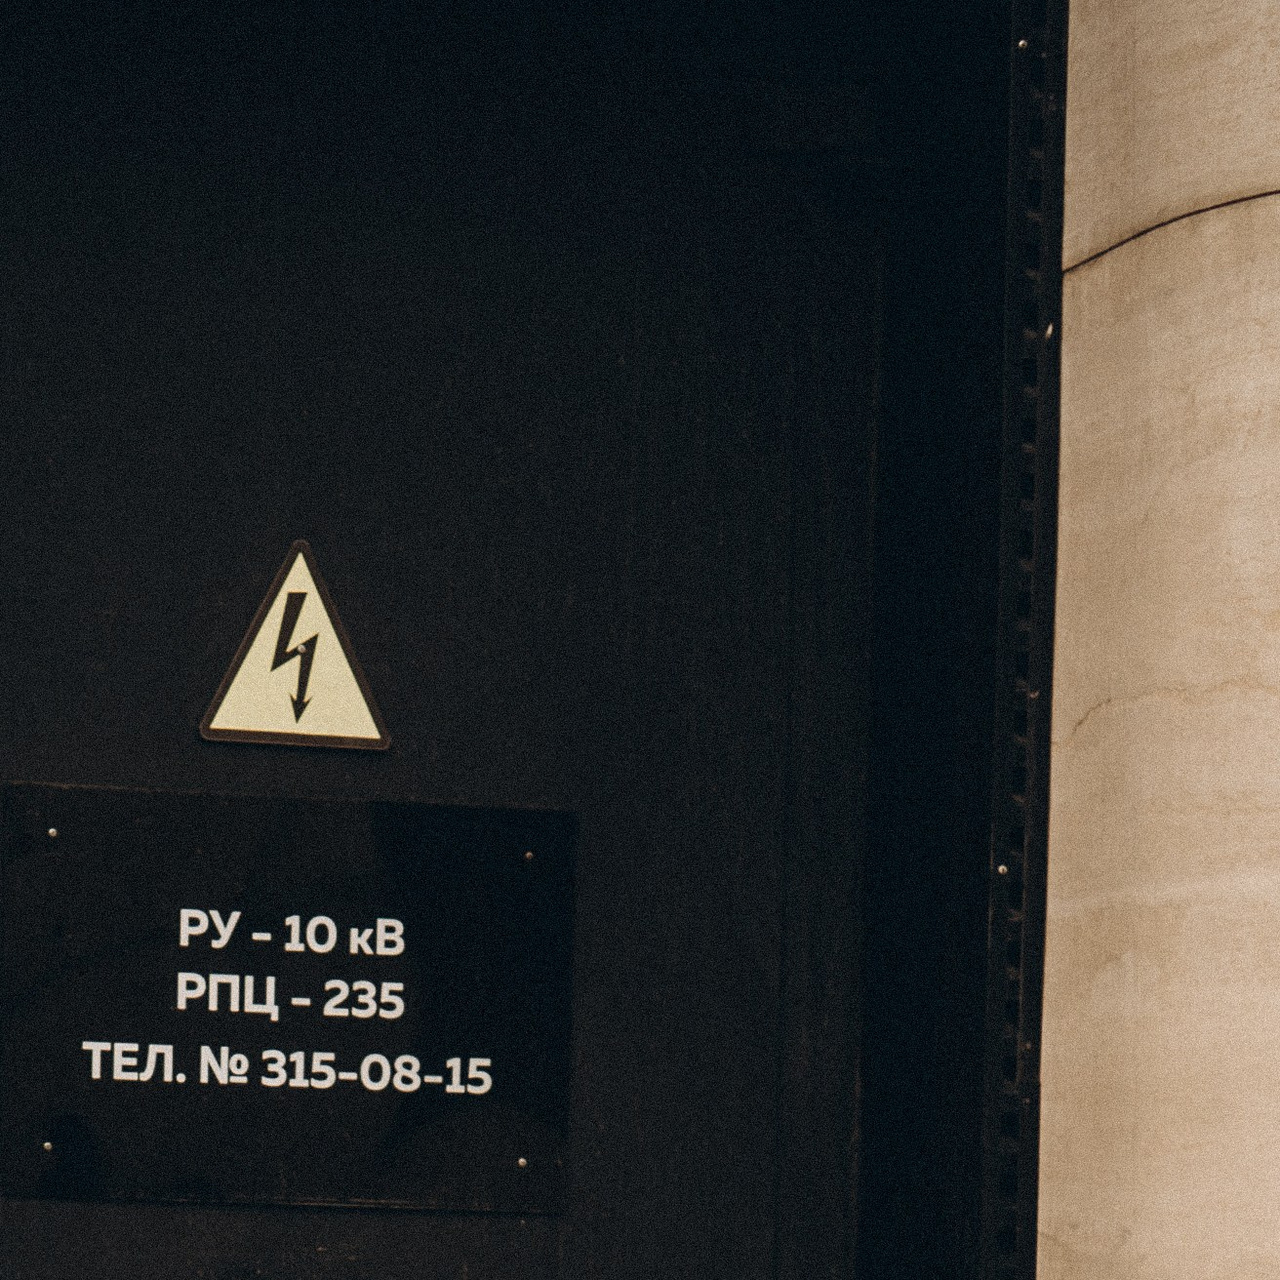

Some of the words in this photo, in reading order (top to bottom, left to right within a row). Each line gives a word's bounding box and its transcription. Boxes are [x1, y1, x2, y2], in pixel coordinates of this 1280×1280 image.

[178, 907, 242, 949] РУ
[284, 914, 338, 954] 10
[349, 917, 405, 956] кВ
[176, 971, 279, 1022] РПЦ
[323, 979, 405, 1020] 235
[81, 1040, 187, 1084] ТЕЛ.
[199, 1045, 250, 1085] №
[260, 1049, 493, 1095] 315-08-15
